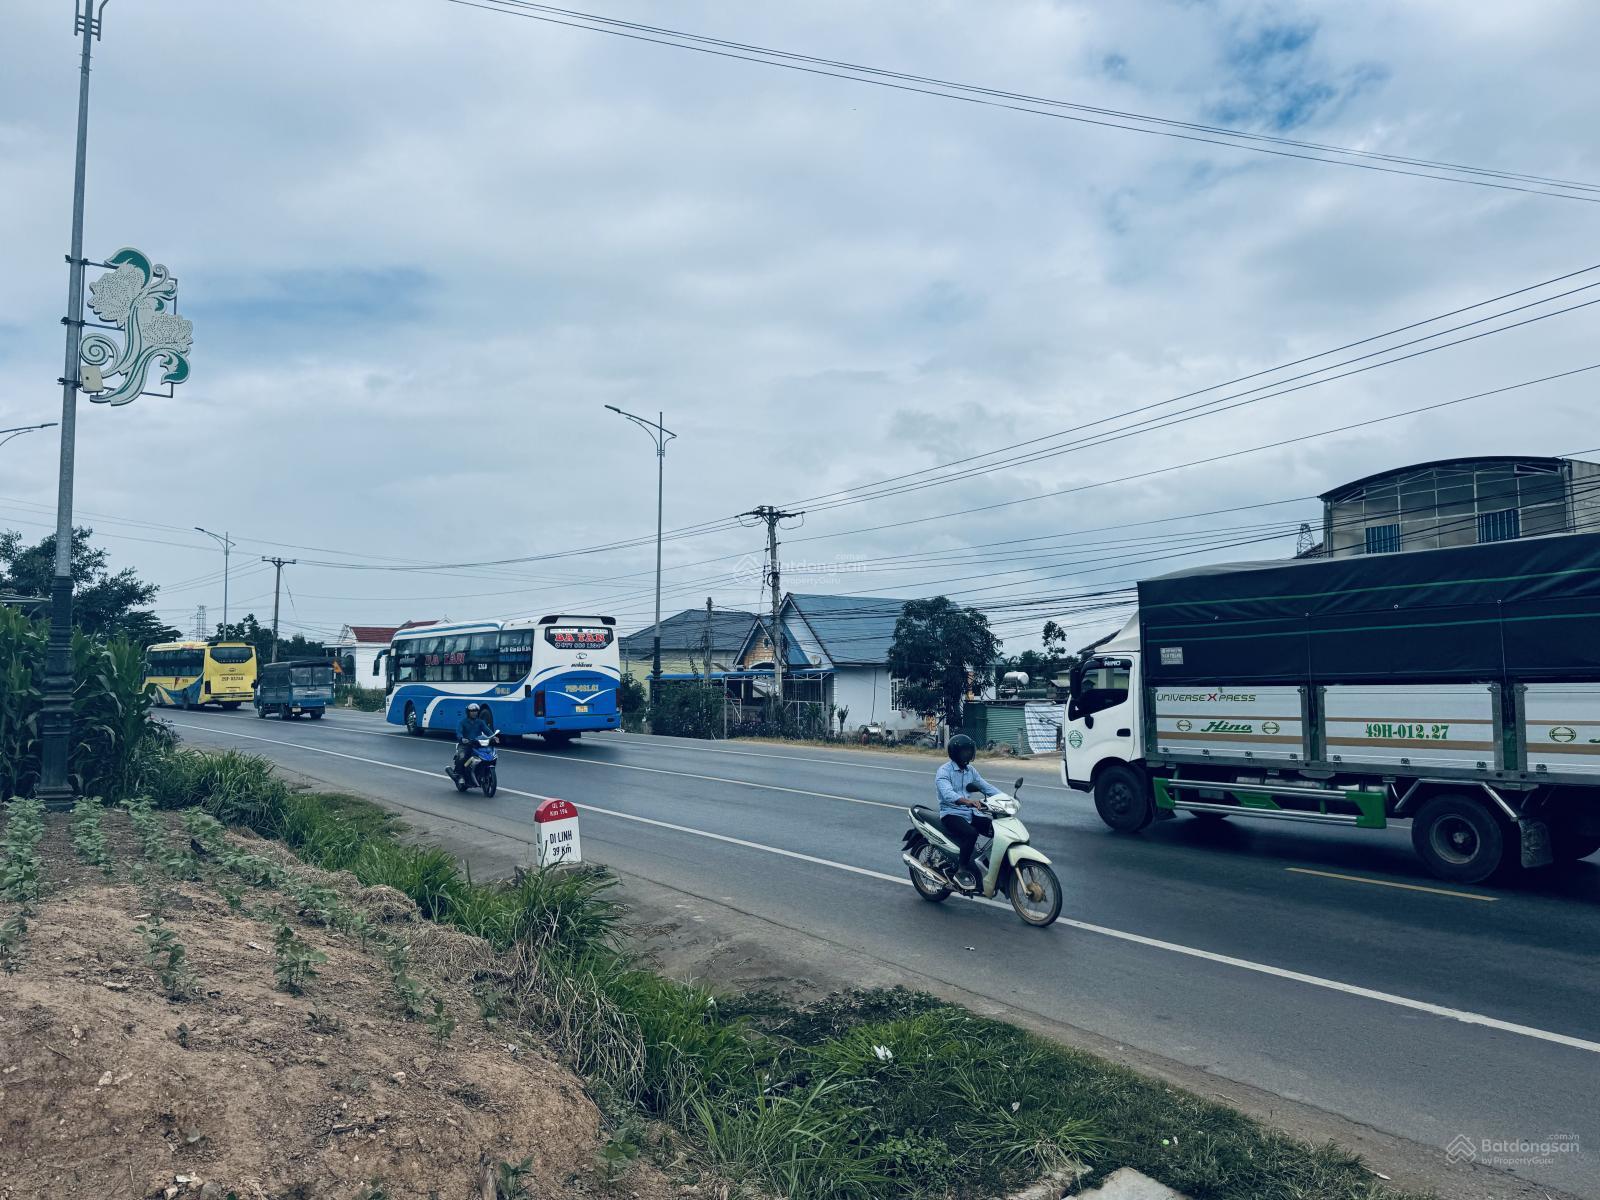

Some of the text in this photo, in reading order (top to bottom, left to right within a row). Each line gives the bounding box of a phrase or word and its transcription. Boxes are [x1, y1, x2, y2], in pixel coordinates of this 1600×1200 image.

[1200, 720, 1252, 734] Hino
[1365, 722, 1449, 740] 49H-012.27
[550, 830, 572, 844] DI LINH
[553, 846, 571, 856] 39 Km
